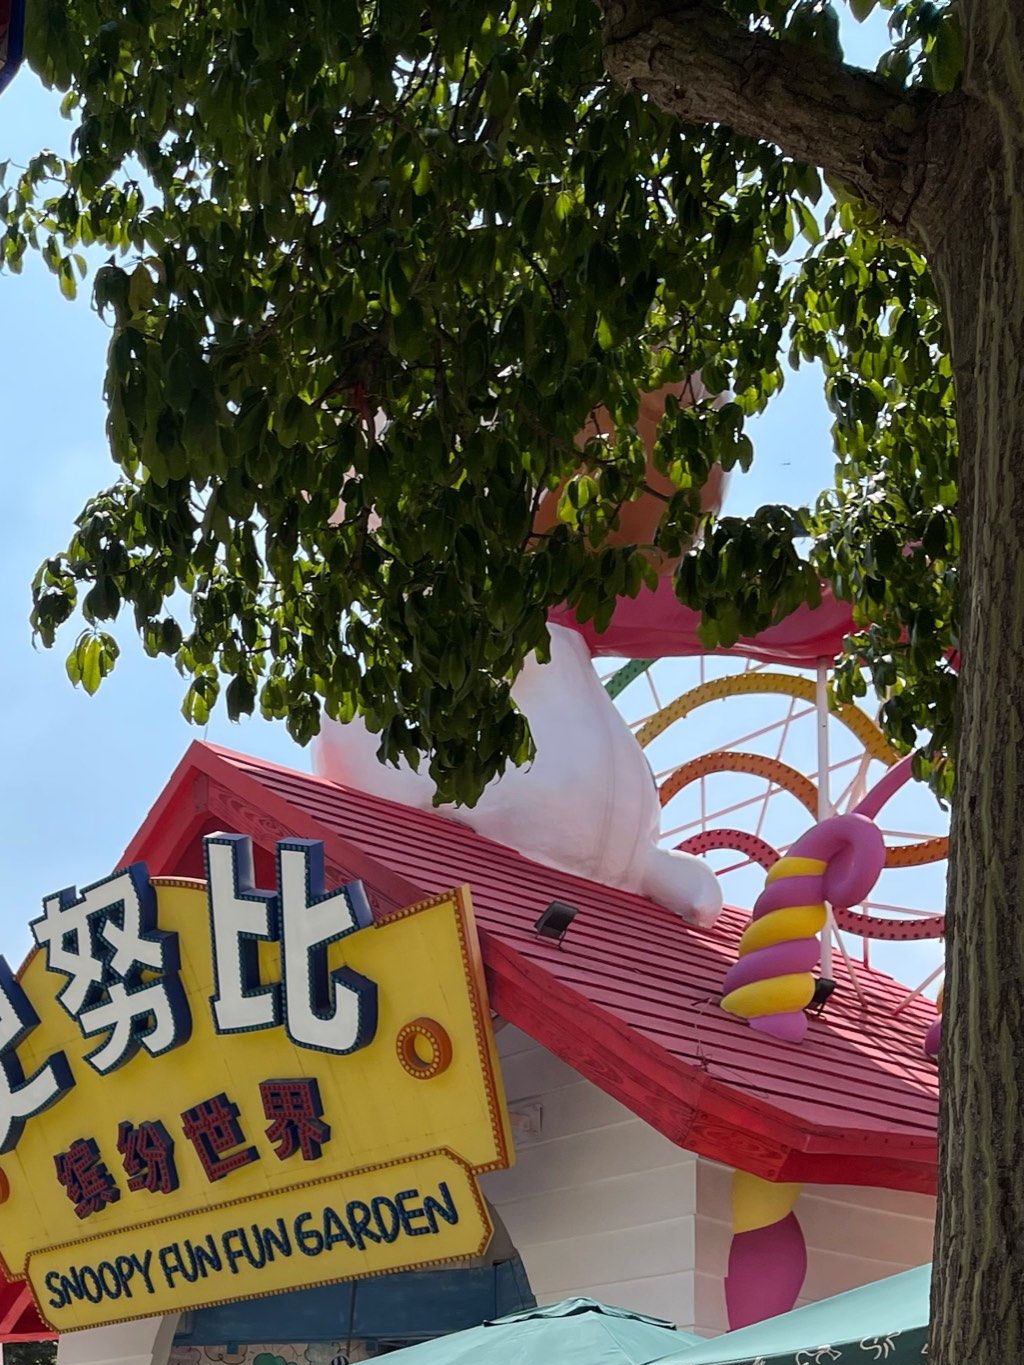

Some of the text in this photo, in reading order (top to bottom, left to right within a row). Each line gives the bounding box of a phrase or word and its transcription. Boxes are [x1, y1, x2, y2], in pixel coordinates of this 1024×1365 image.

[53, 1077, 331, 1219] 缤纷世界
[45, 1181, 459, 1308] SNOOPY FUN FUN GARDEN
